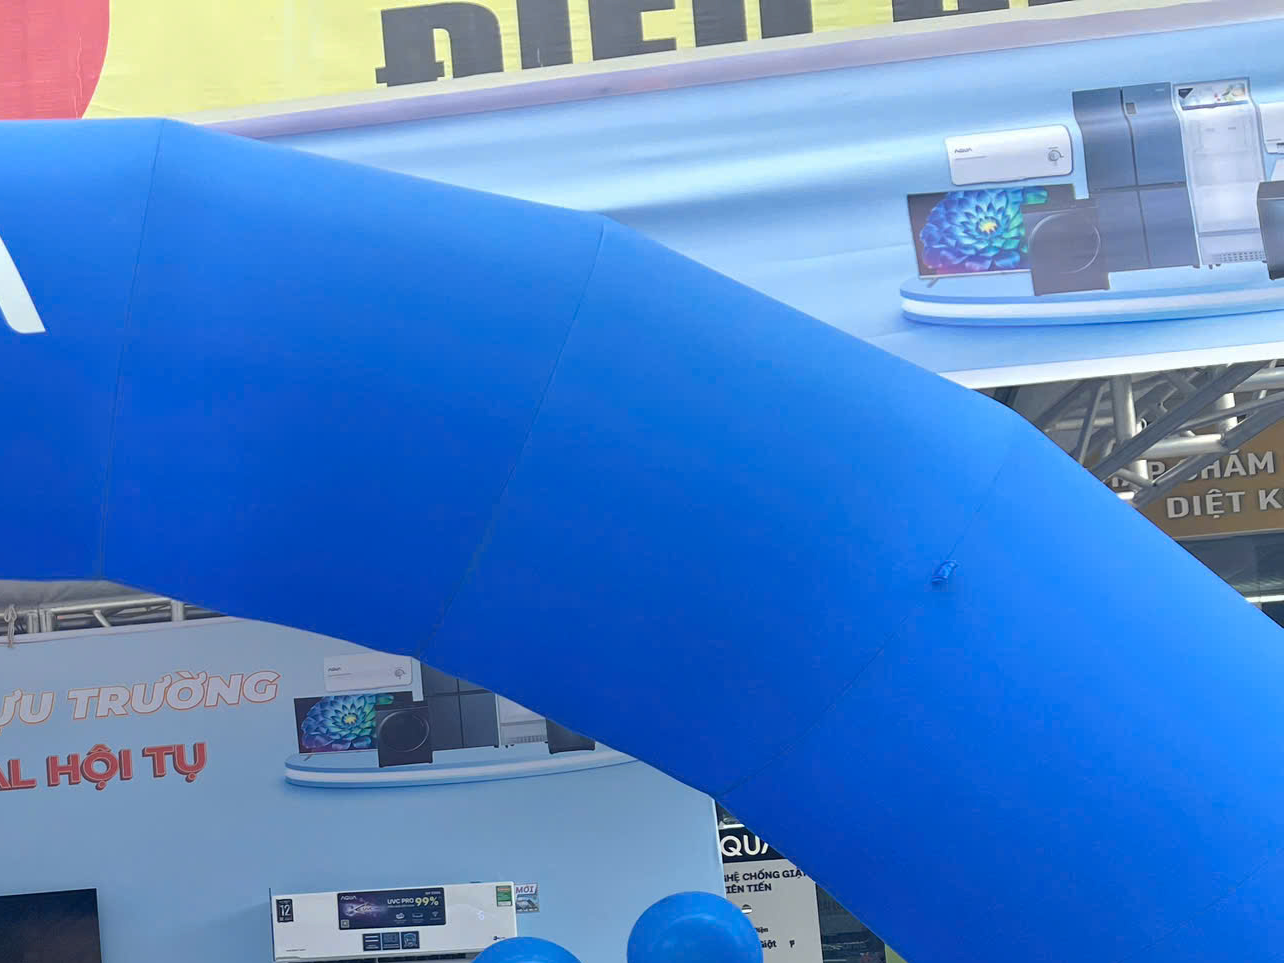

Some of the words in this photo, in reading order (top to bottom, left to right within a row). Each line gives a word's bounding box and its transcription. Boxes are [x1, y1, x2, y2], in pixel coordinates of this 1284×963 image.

[1166, 488, 1245, 519] DIỆT
[68, 670, 281, 720] TRƯỜNG
[47, 743, 133, 790] HỘI
[143, 741, 208, 782] TỤ
[719, 834, 769, 857] QU
[743, 868, 780, 881] CHỐNG
[726, 884, 745, 894] IÊN
[279, 905, 291, 916] 12
[415, 896, 439, 907] 99%
